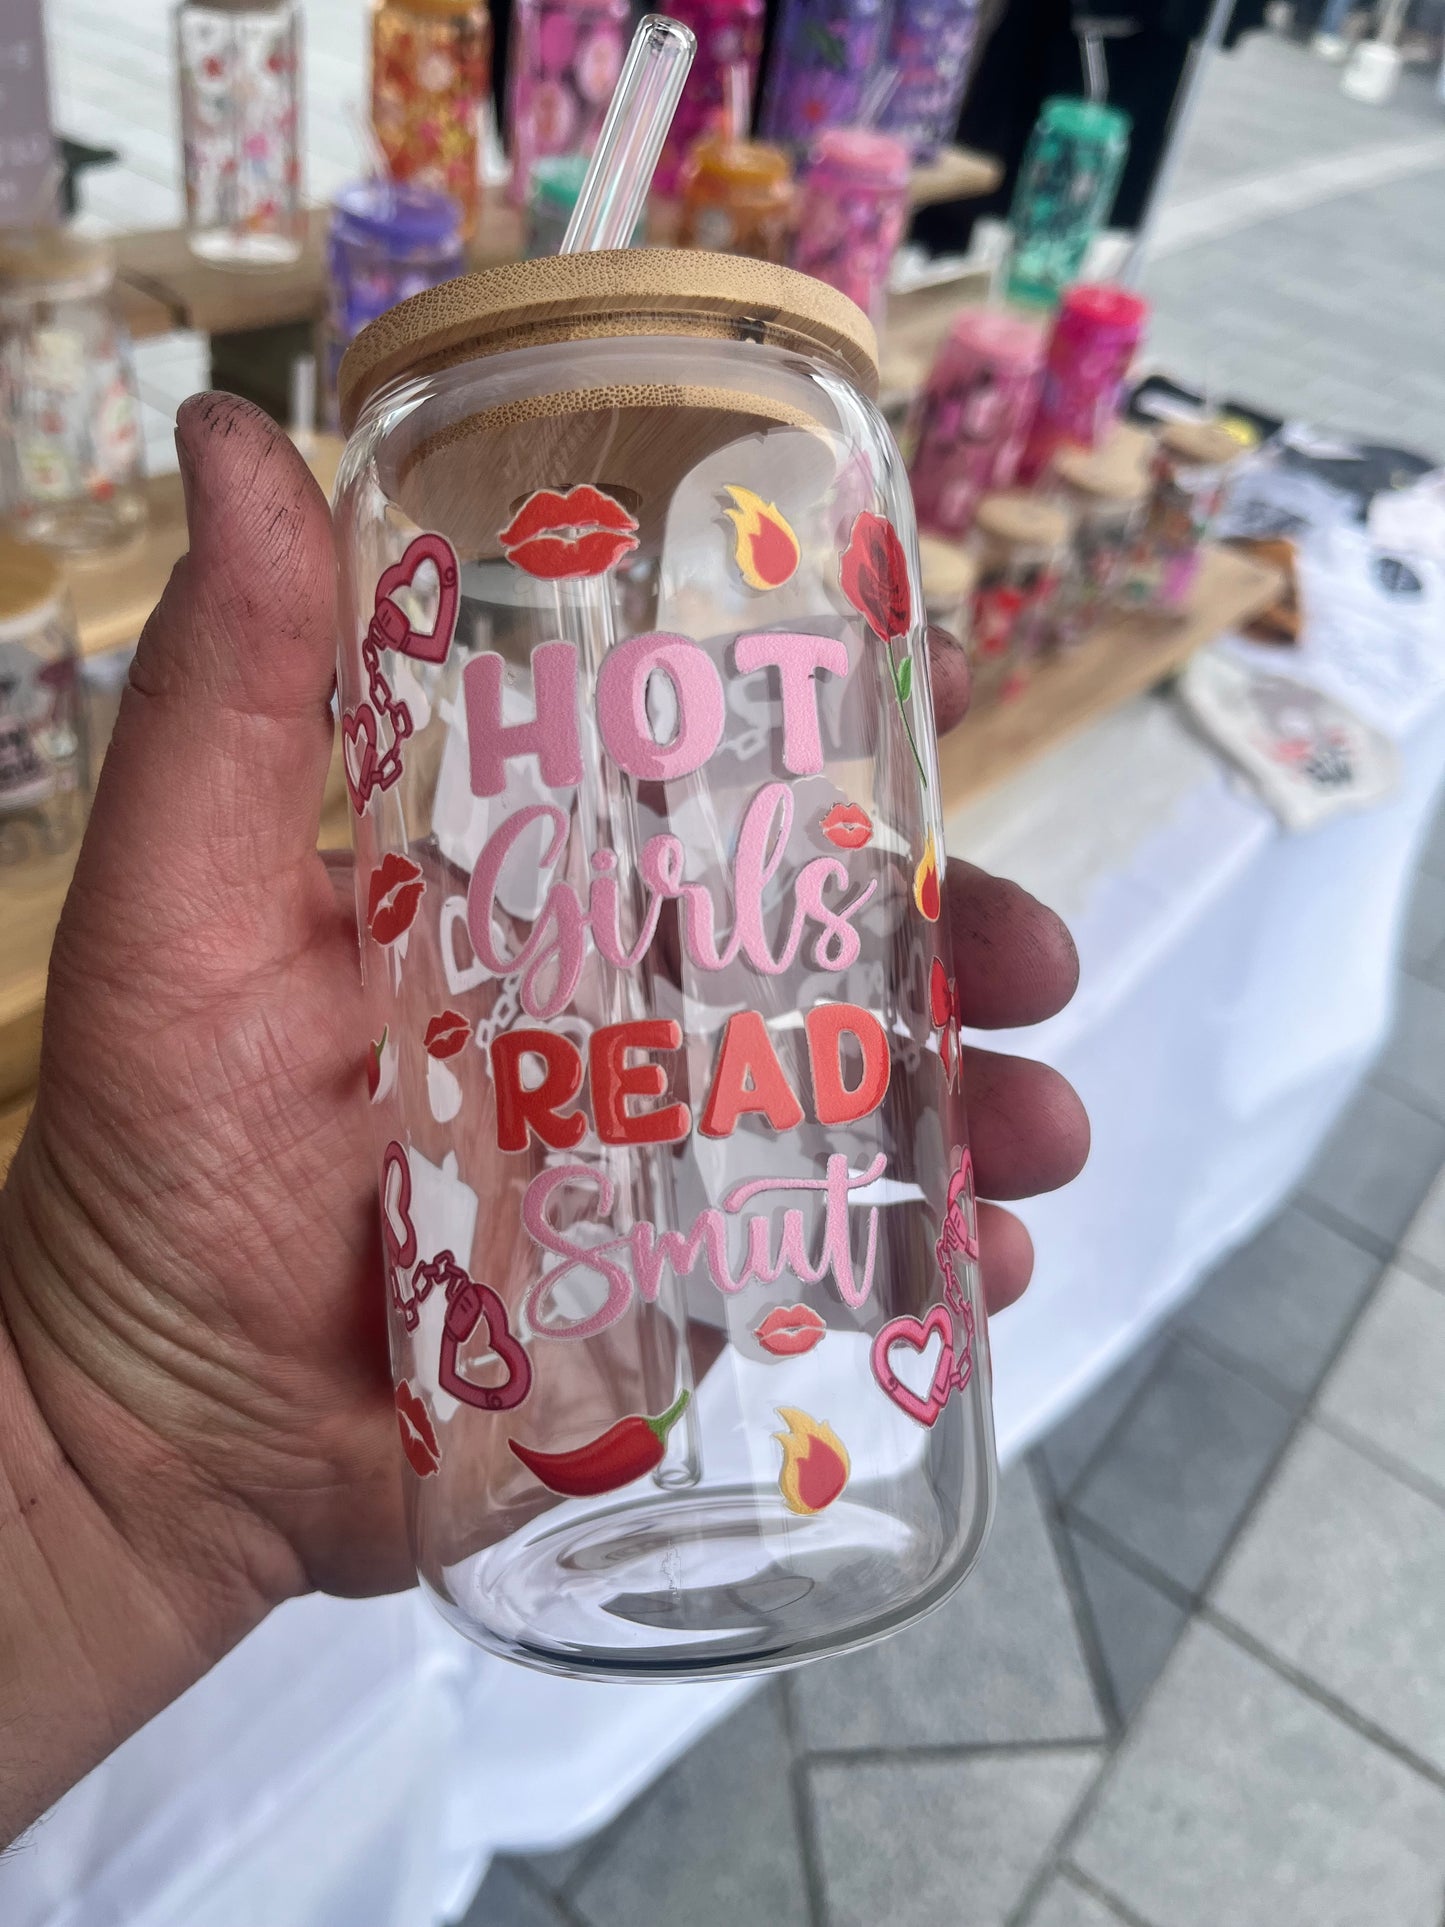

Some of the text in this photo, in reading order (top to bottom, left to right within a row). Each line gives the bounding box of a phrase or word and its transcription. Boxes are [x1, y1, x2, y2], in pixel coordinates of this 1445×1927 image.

[463, 632, 849, 797] HOT
[467, 783, 878, 1019] Girls
[490, 1003, 891, 1152] READ
[523, 1152, 887, 1340] Smut
